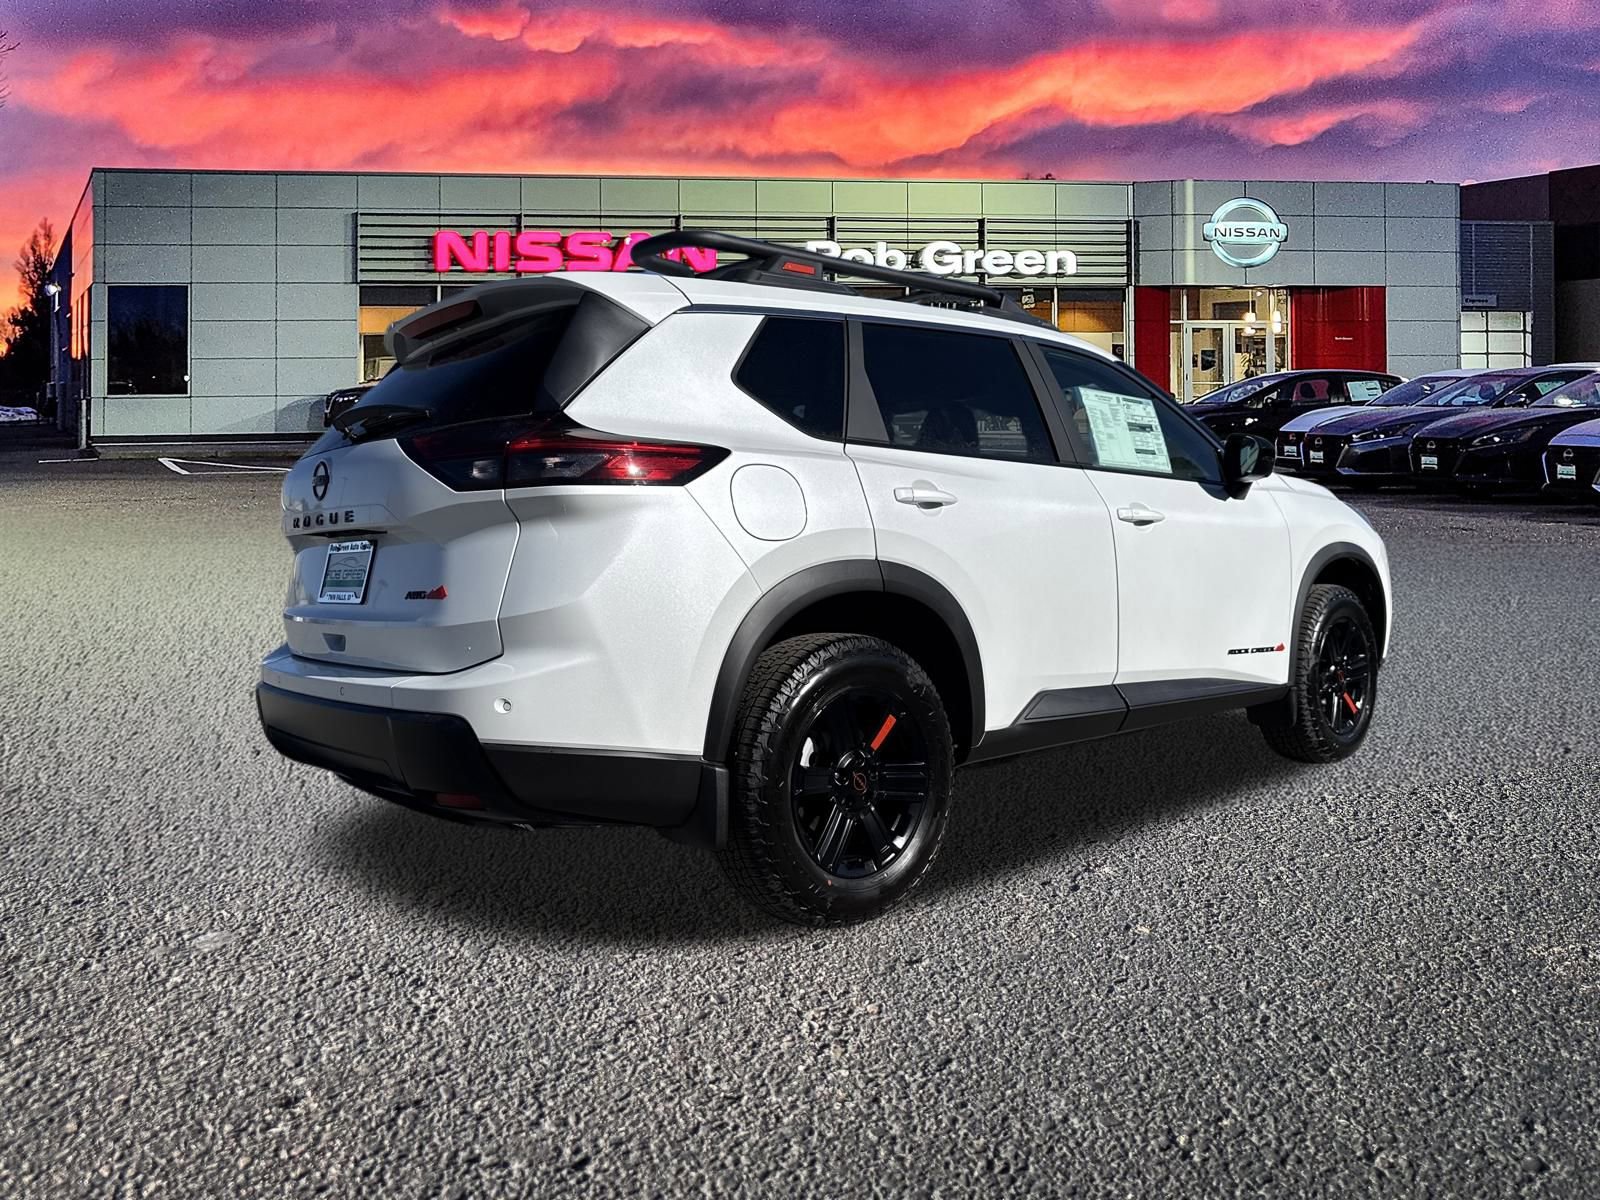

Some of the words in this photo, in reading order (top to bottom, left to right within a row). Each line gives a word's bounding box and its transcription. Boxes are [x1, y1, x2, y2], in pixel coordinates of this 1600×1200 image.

[1213, 227, 1281, 239] NISSAN
[920, 240, 1079, 275] Green
[292, 510, 356, 529] ROGUE
